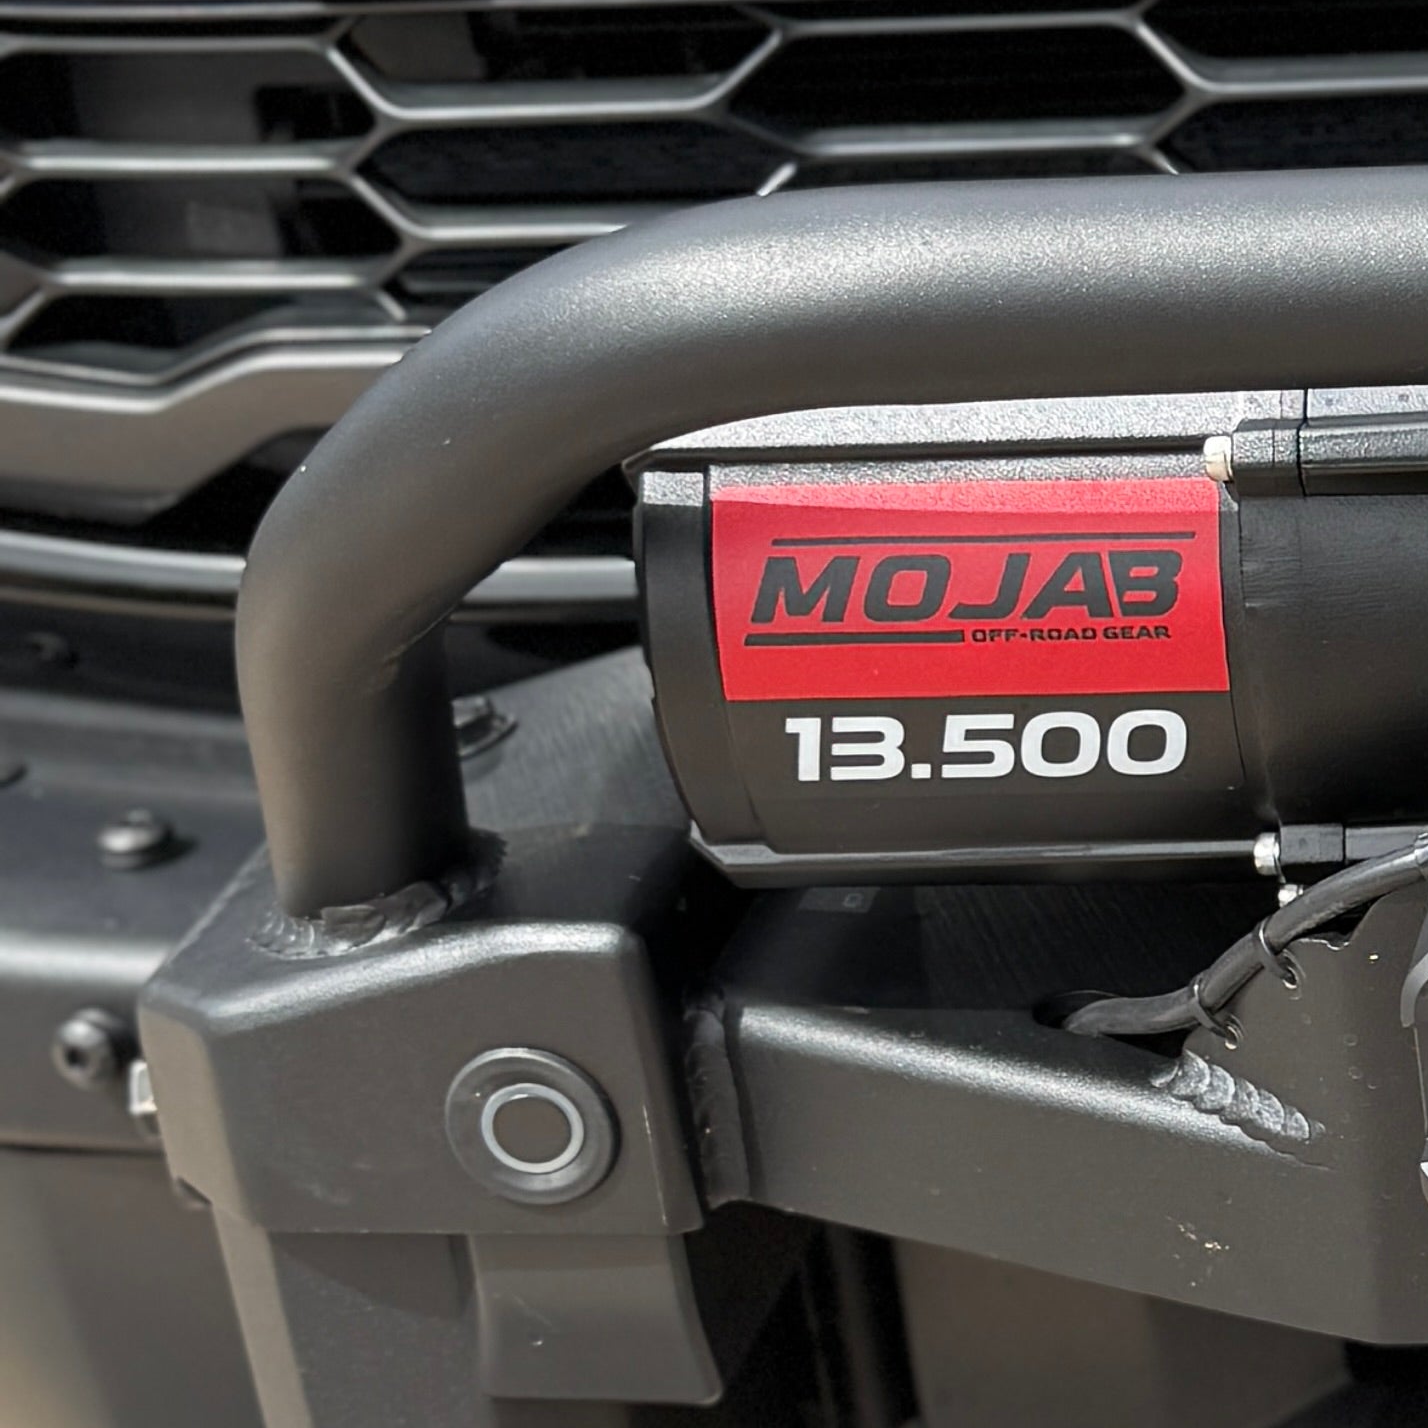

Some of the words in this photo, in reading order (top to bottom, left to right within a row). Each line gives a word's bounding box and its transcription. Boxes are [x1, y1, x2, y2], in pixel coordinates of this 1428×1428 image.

[750, 548, 1185, 624] MOJAB
[971, 627, 1097, 643] OFF-ROAD
[1102, 625, 1172, 640] GEAR
[784, 709, 1188, 783] 13.500
